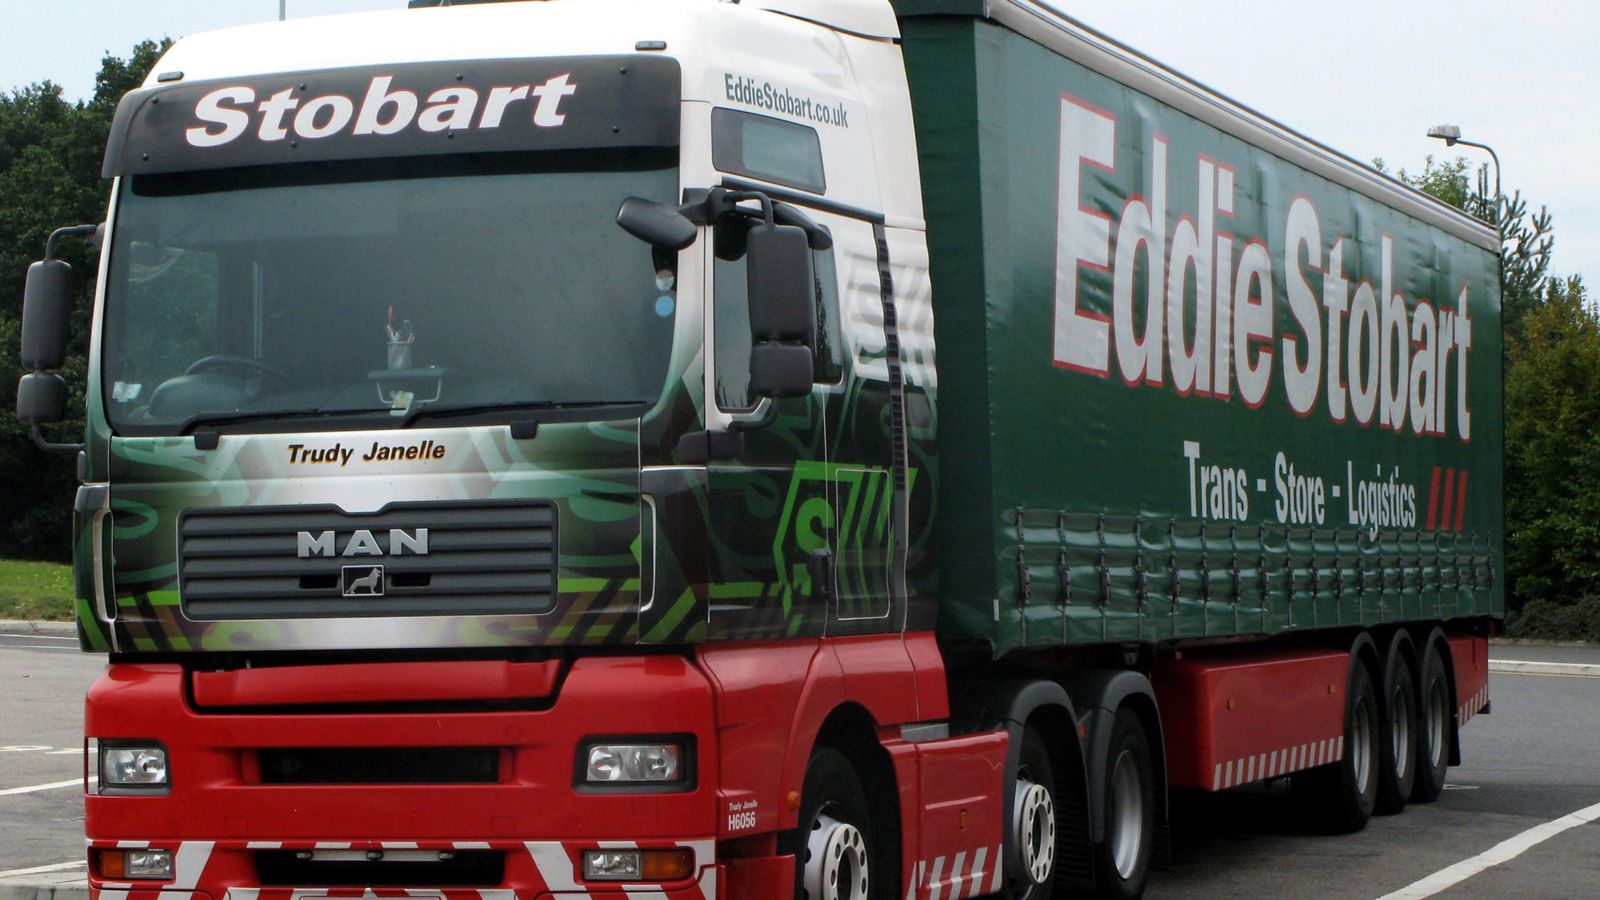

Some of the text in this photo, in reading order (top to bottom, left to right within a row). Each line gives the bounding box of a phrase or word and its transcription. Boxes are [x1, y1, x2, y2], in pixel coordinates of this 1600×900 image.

[185, 73, 577, 147] Stobart
[724, 72, 848, 128] EddieStobart.co.uk
[288, 440, 446, 466] Trudy Janelle
[1184, 440, 1248, 521] Trans
[1275, 451, 1325, 525] Store
[1347, 460, 1416, 542] Logistics
[297, 528, 428, 558] MAN
[728, 811, 756, 831] H6056
